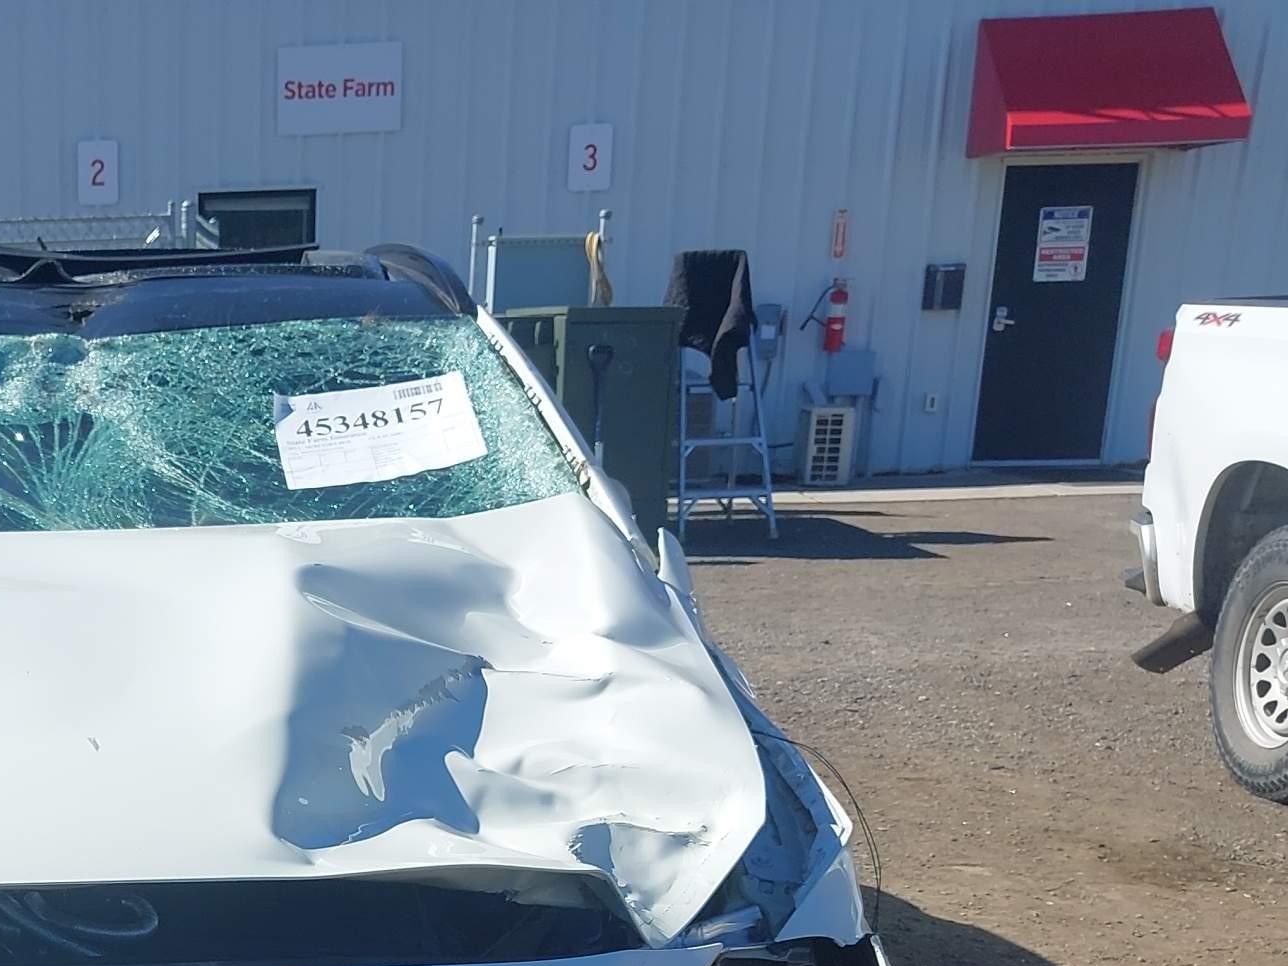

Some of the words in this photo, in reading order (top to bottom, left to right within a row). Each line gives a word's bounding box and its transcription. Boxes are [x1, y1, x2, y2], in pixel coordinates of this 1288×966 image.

[283, 80, 337, 101] State
[342, 77, 395, 98] Farm
[582, 143, 598, 171] 3
[90, 158, 105, 187] 2
[296, 397, 444, 437] 45348157
